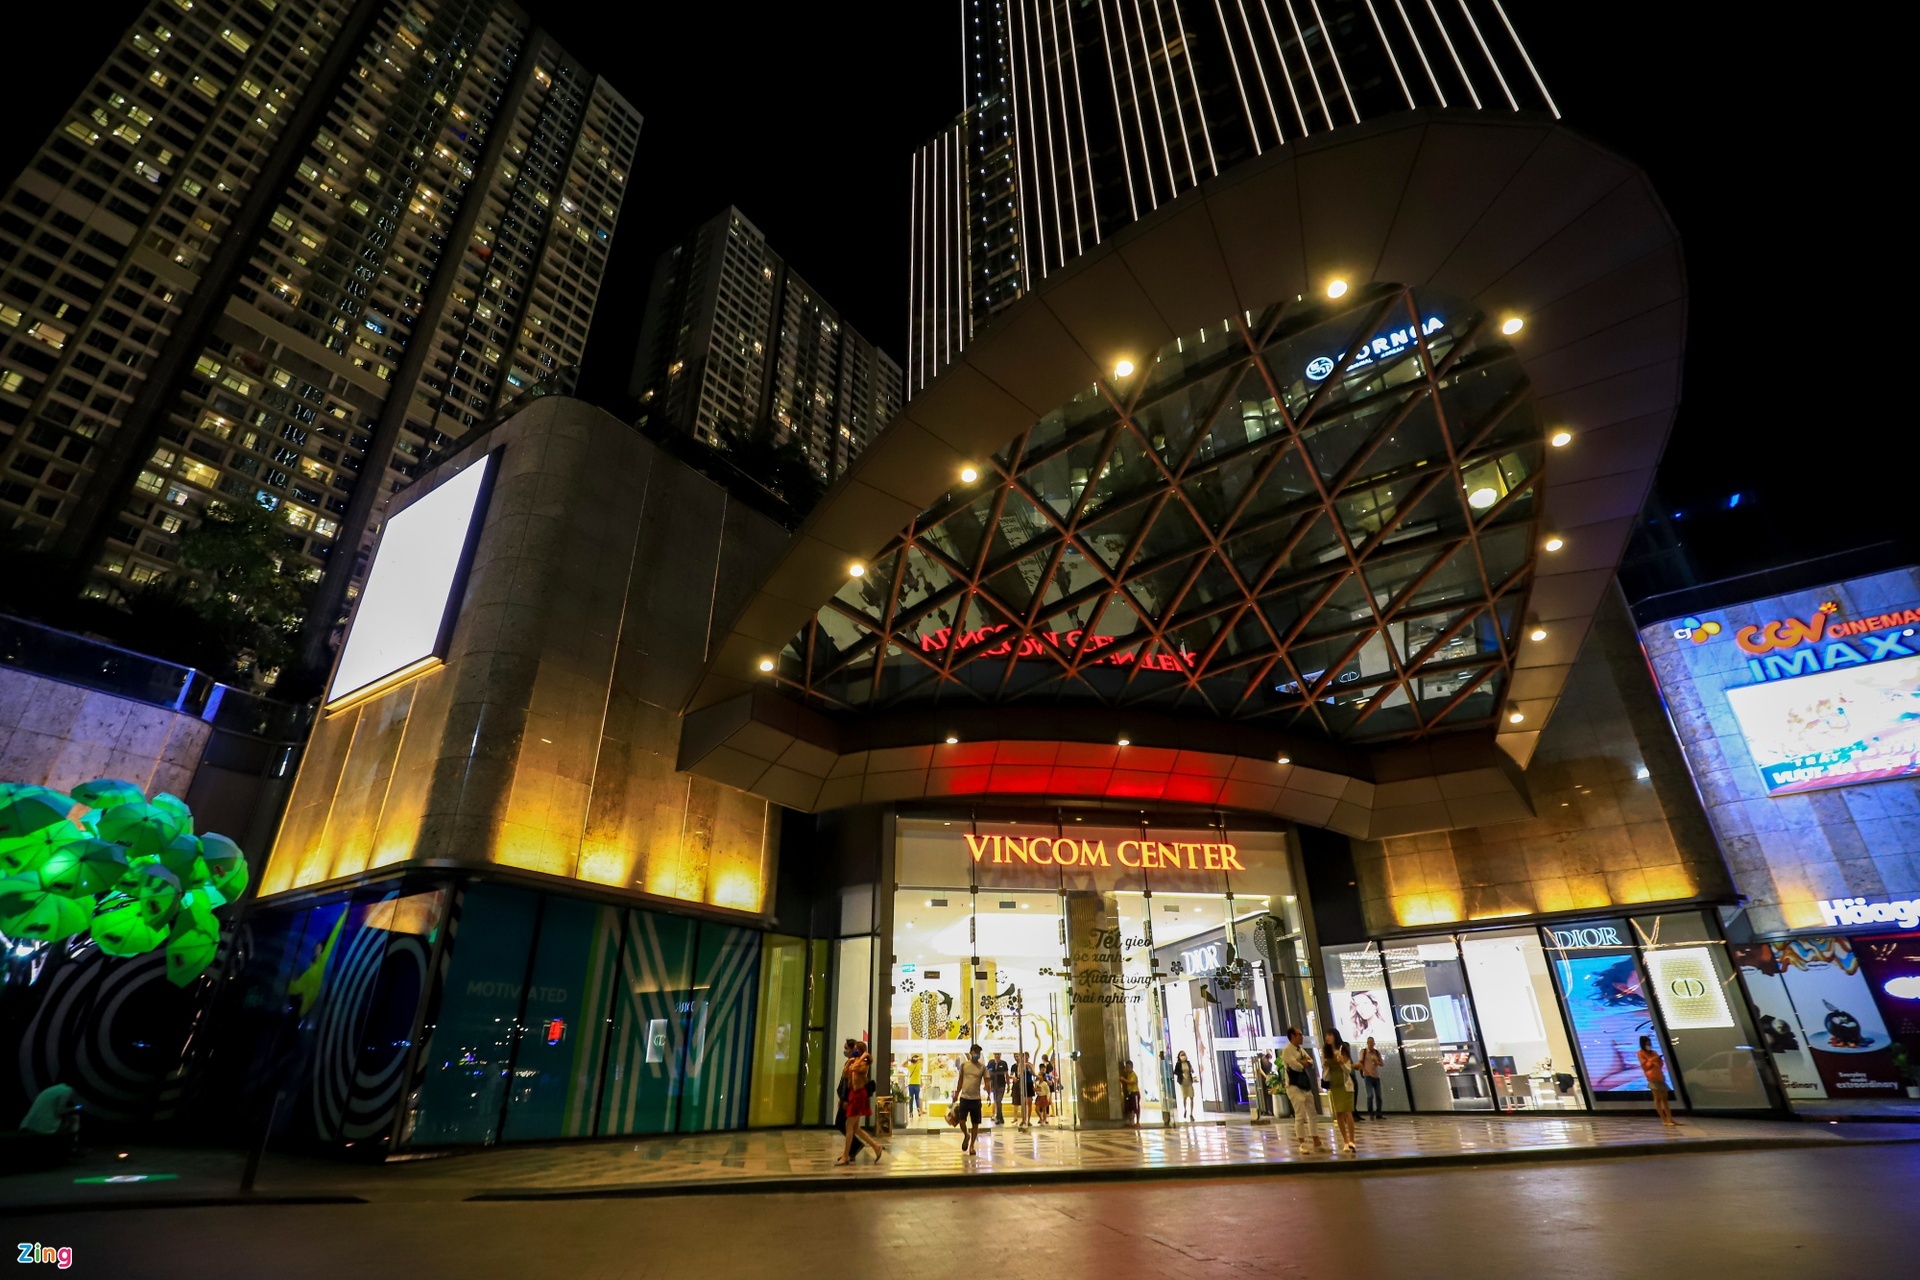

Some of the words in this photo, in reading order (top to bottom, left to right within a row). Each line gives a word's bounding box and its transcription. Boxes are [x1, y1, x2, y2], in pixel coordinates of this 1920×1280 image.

[1736, 612, 1826, 654] CGV
[1748, 630, 1914, 683] IMAX
[964, 834, 1111, 867] VINCOM
[1117, 840, 1246, 871] CENTER
[1818, 897, 1920, 928] Häag
[1089, 926, 1122, 949] Tết
[1125, 936, 1152, 951] gieo
[1554, 926, 1622, 948] DIOR
[1180, 945, 1221, 976] DIOR
[466, 980, 568, 1003] MOTIVATED
[1835, 1079, 1898, 1090] extraordinary
